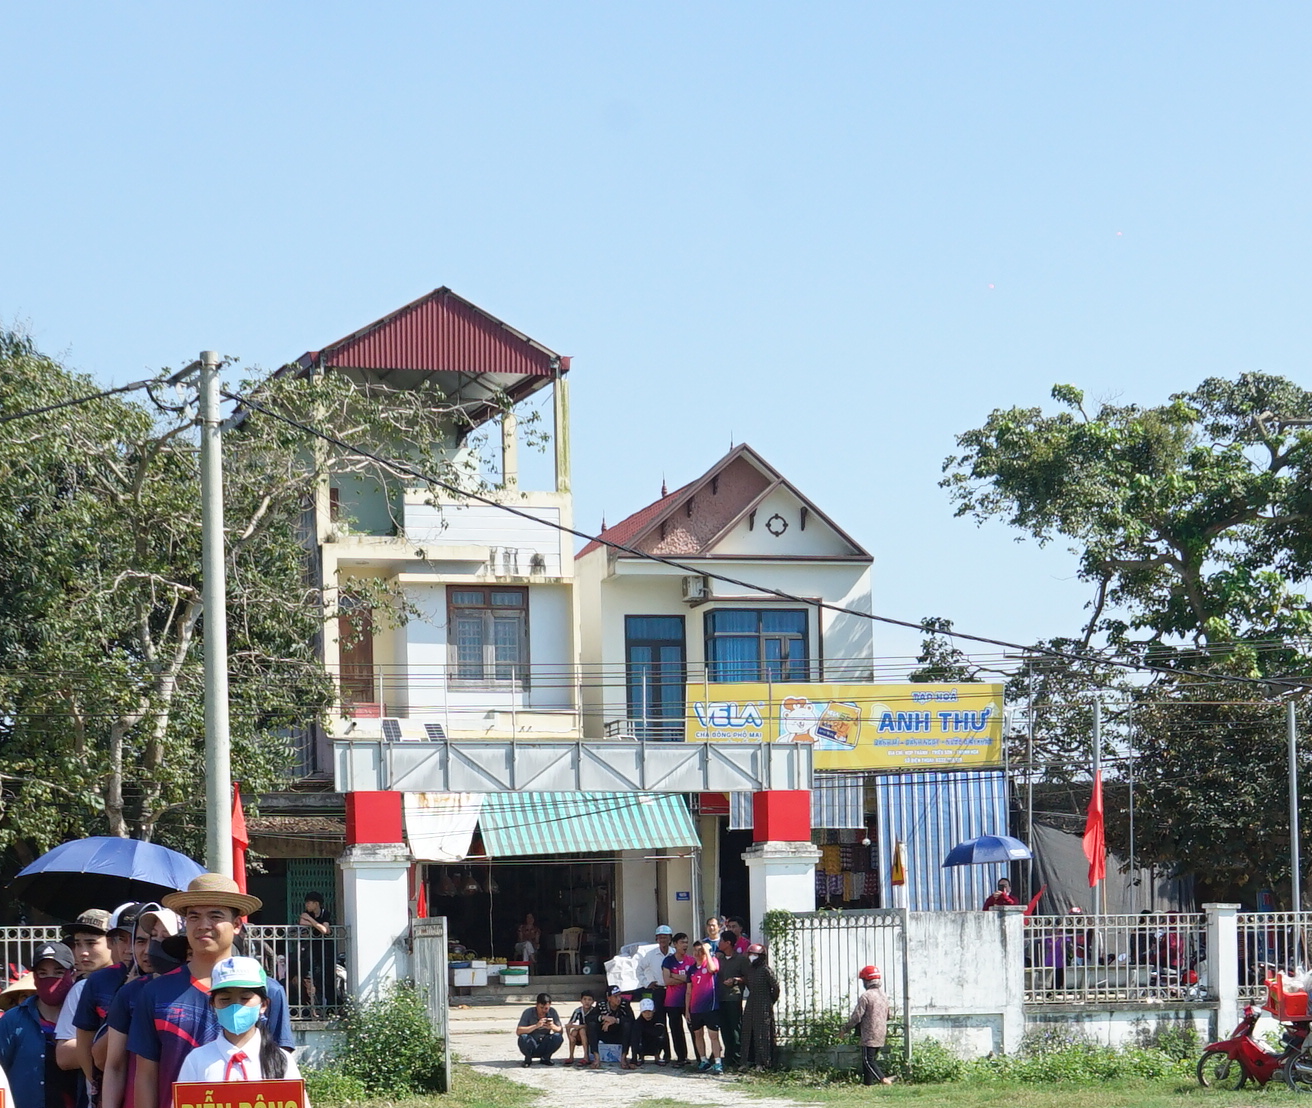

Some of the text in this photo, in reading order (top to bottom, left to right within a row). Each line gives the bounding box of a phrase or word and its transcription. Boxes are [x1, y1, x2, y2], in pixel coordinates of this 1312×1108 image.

[694, 701, 763, 727] VELA
[878, 708, 992, 731] ANH THƯ
[697, 976, 701, 984] 7
